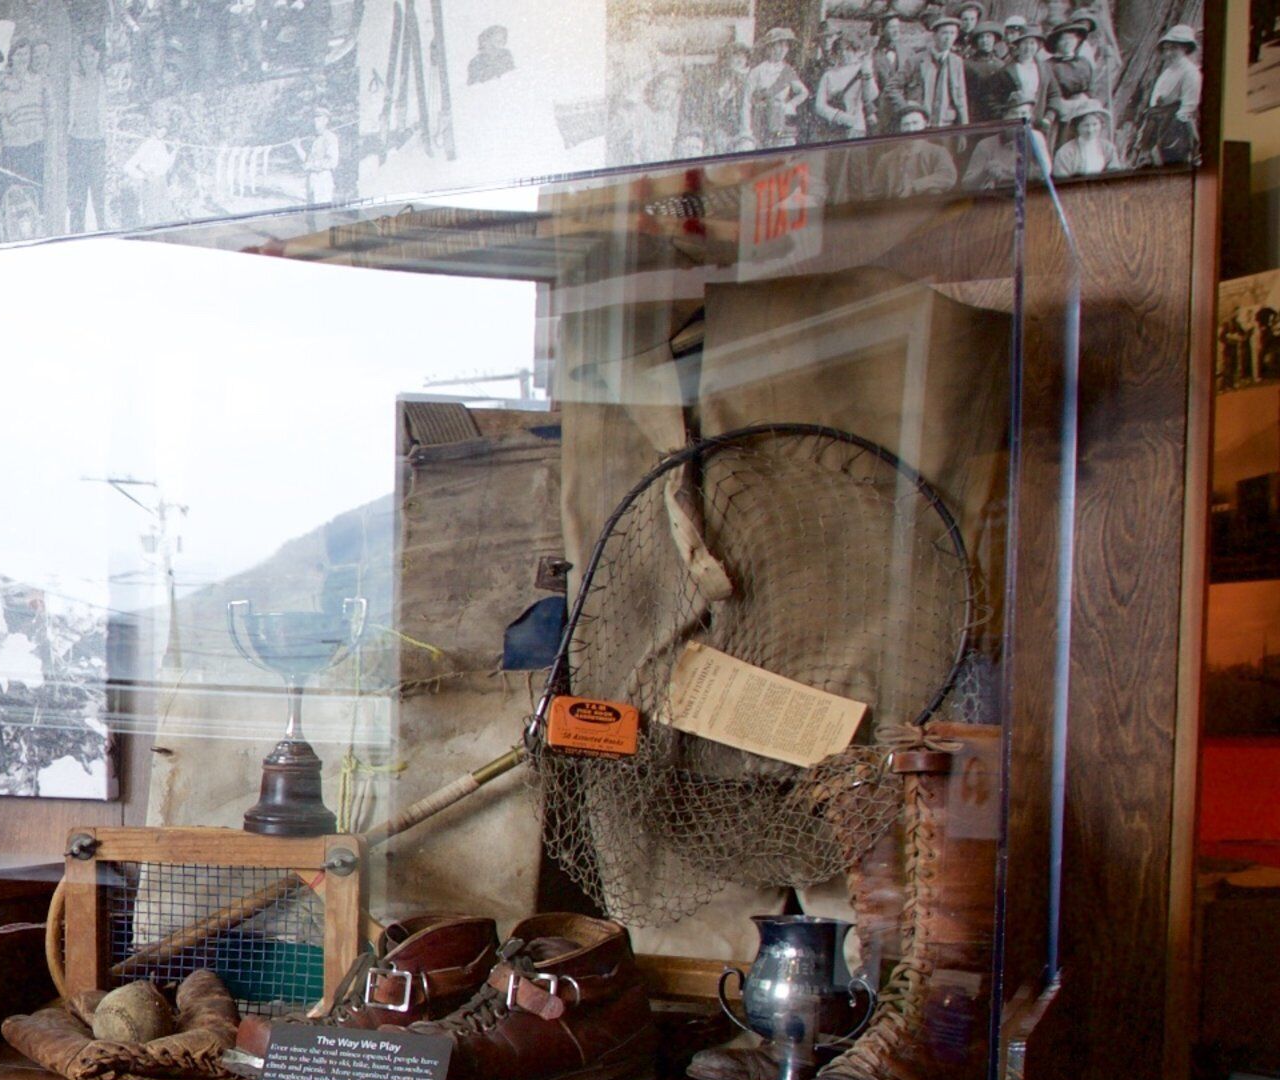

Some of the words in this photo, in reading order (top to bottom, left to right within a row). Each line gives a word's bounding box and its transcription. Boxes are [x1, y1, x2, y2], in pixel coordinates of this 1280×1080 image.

[317, 1035, 336, 1046] The
[338, 1038, 360, 1050] Way
[361, 1040, 378, 1050] We
[379, 1041, 401, 1054] Play
[270, 1043, 288, 1051] Ever
[290, 1045, 308, 1053] since
[362, 1054, 392, 1062] opened,
[393, 1056, 419, 1064] people
[420, 1057, 439, 1066] have
[266, 1062, 287, 1070] climb
[288, 1063, 302, 1071] and
[302, 1065, 326, 1074] picnic.
[331, 1068, 351, 1076] More
[299, 1055, 311, 1063] the
[312, 1056, 327, 1064] hills
[338, 1059, 351, 1067] ski,
[352, 1060, 370, 1069] hike,
[372, 1062, 392, 1071] hunt,
[393, 1065, 433, 1075] snowshoe,
